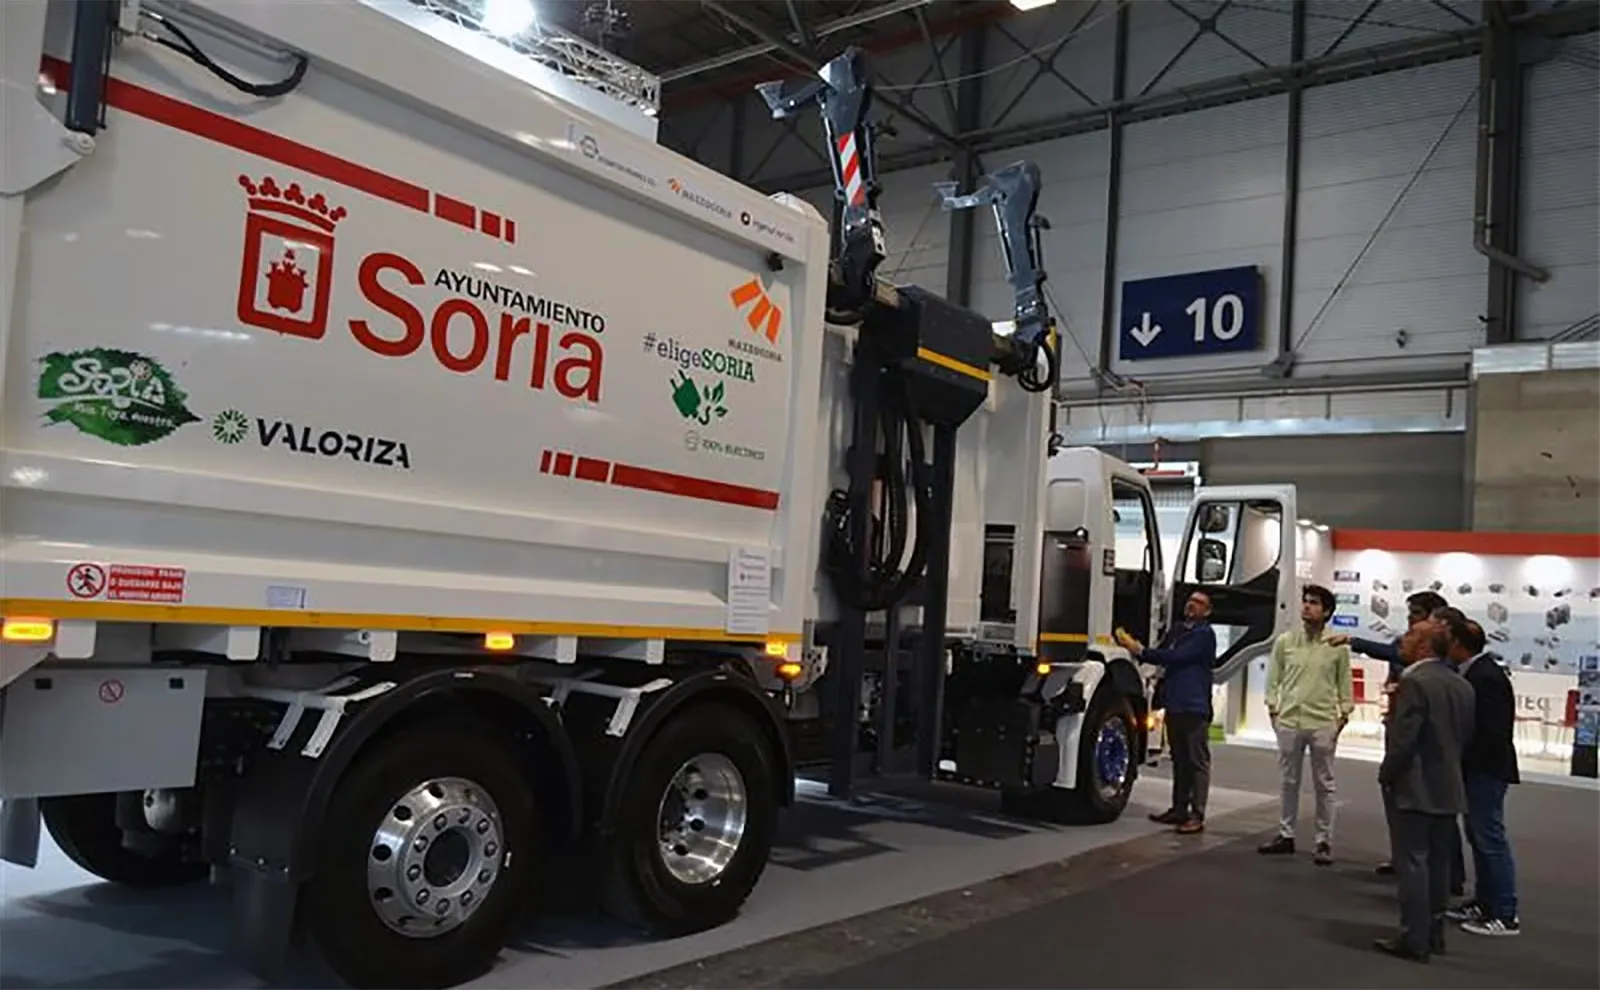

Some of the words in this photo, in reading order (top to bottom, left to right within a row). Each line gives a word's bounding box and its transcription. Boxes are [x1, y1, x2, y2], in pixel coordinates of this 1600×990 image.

[435, 268, 605, 333] AYUNTAMIENTO
[1186, 293, 1244, 341] 10
[348, 252, 604, 403] Soria
[643, 332, 755, 382] #eligeSORIA
[256, 418, 410, 469] VALORIZA
